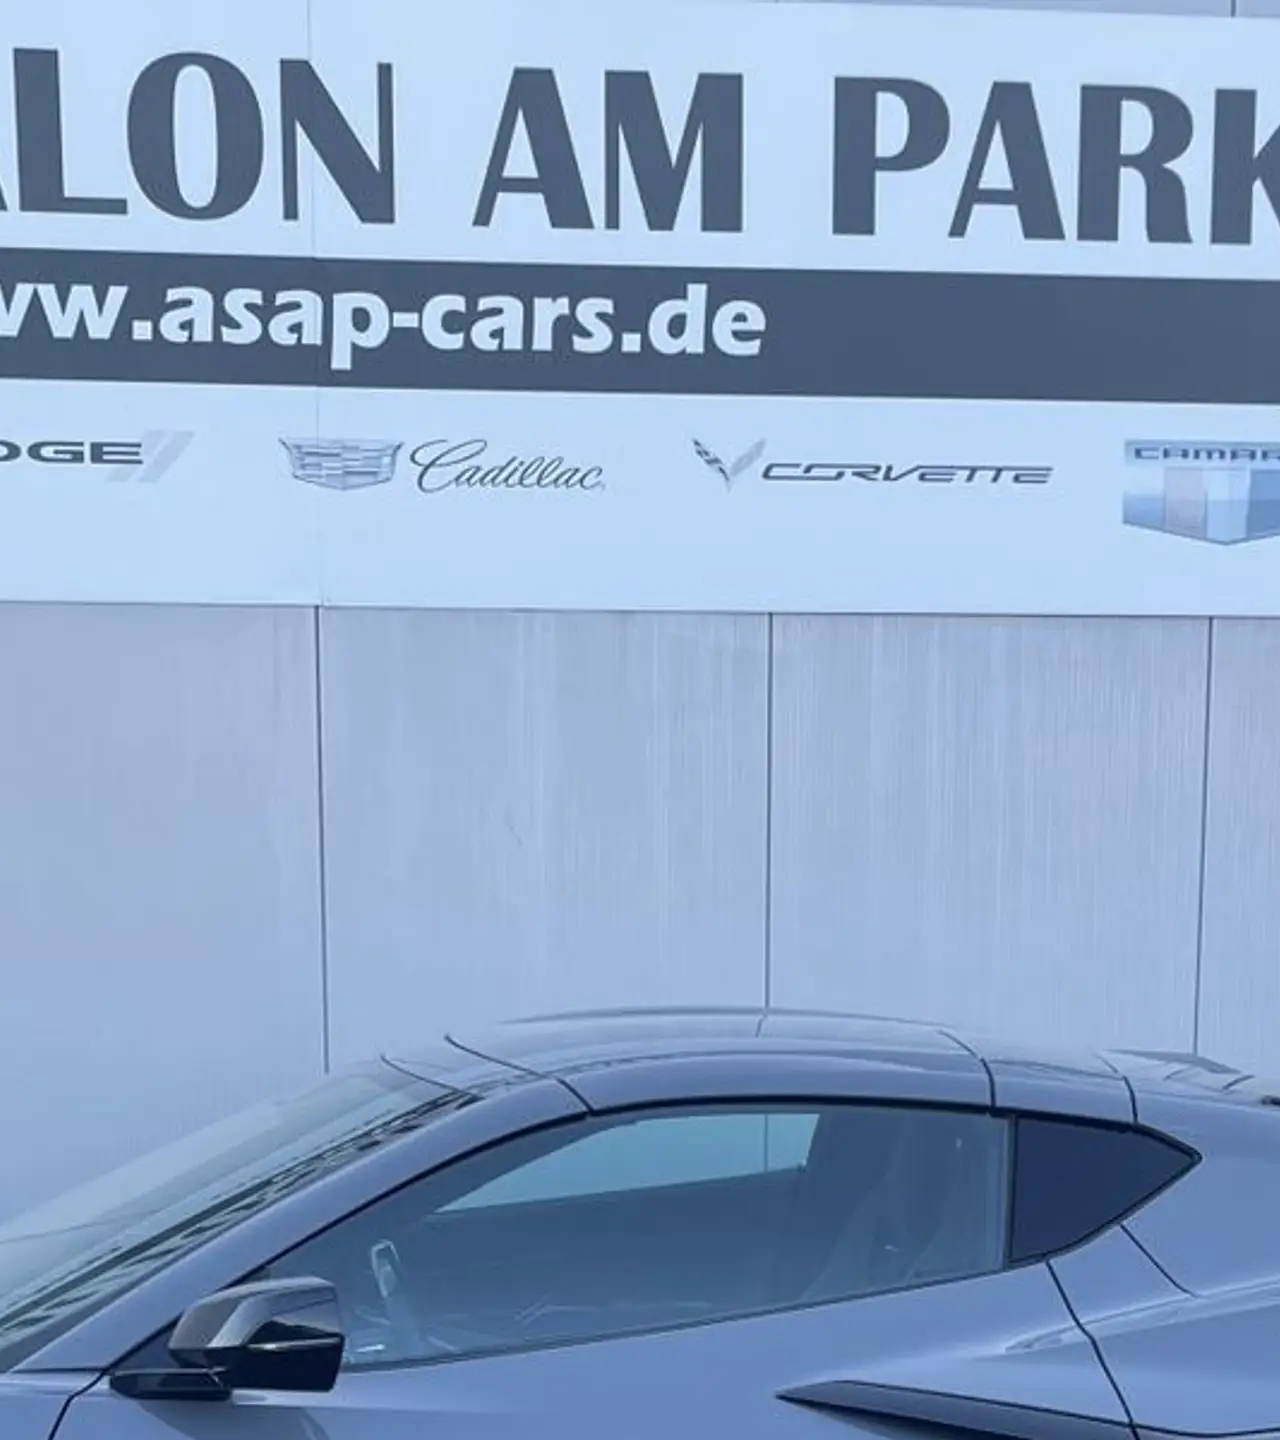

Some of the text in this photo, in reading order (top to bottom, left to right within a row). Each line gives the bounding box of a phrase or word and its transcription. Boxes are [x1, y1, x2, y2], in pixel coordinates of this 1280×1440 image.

[472, 66, 744, 233] AM
[409, 438, 605, 494] Cadillac
[761, 462, 1055, 485] CORVETTE
